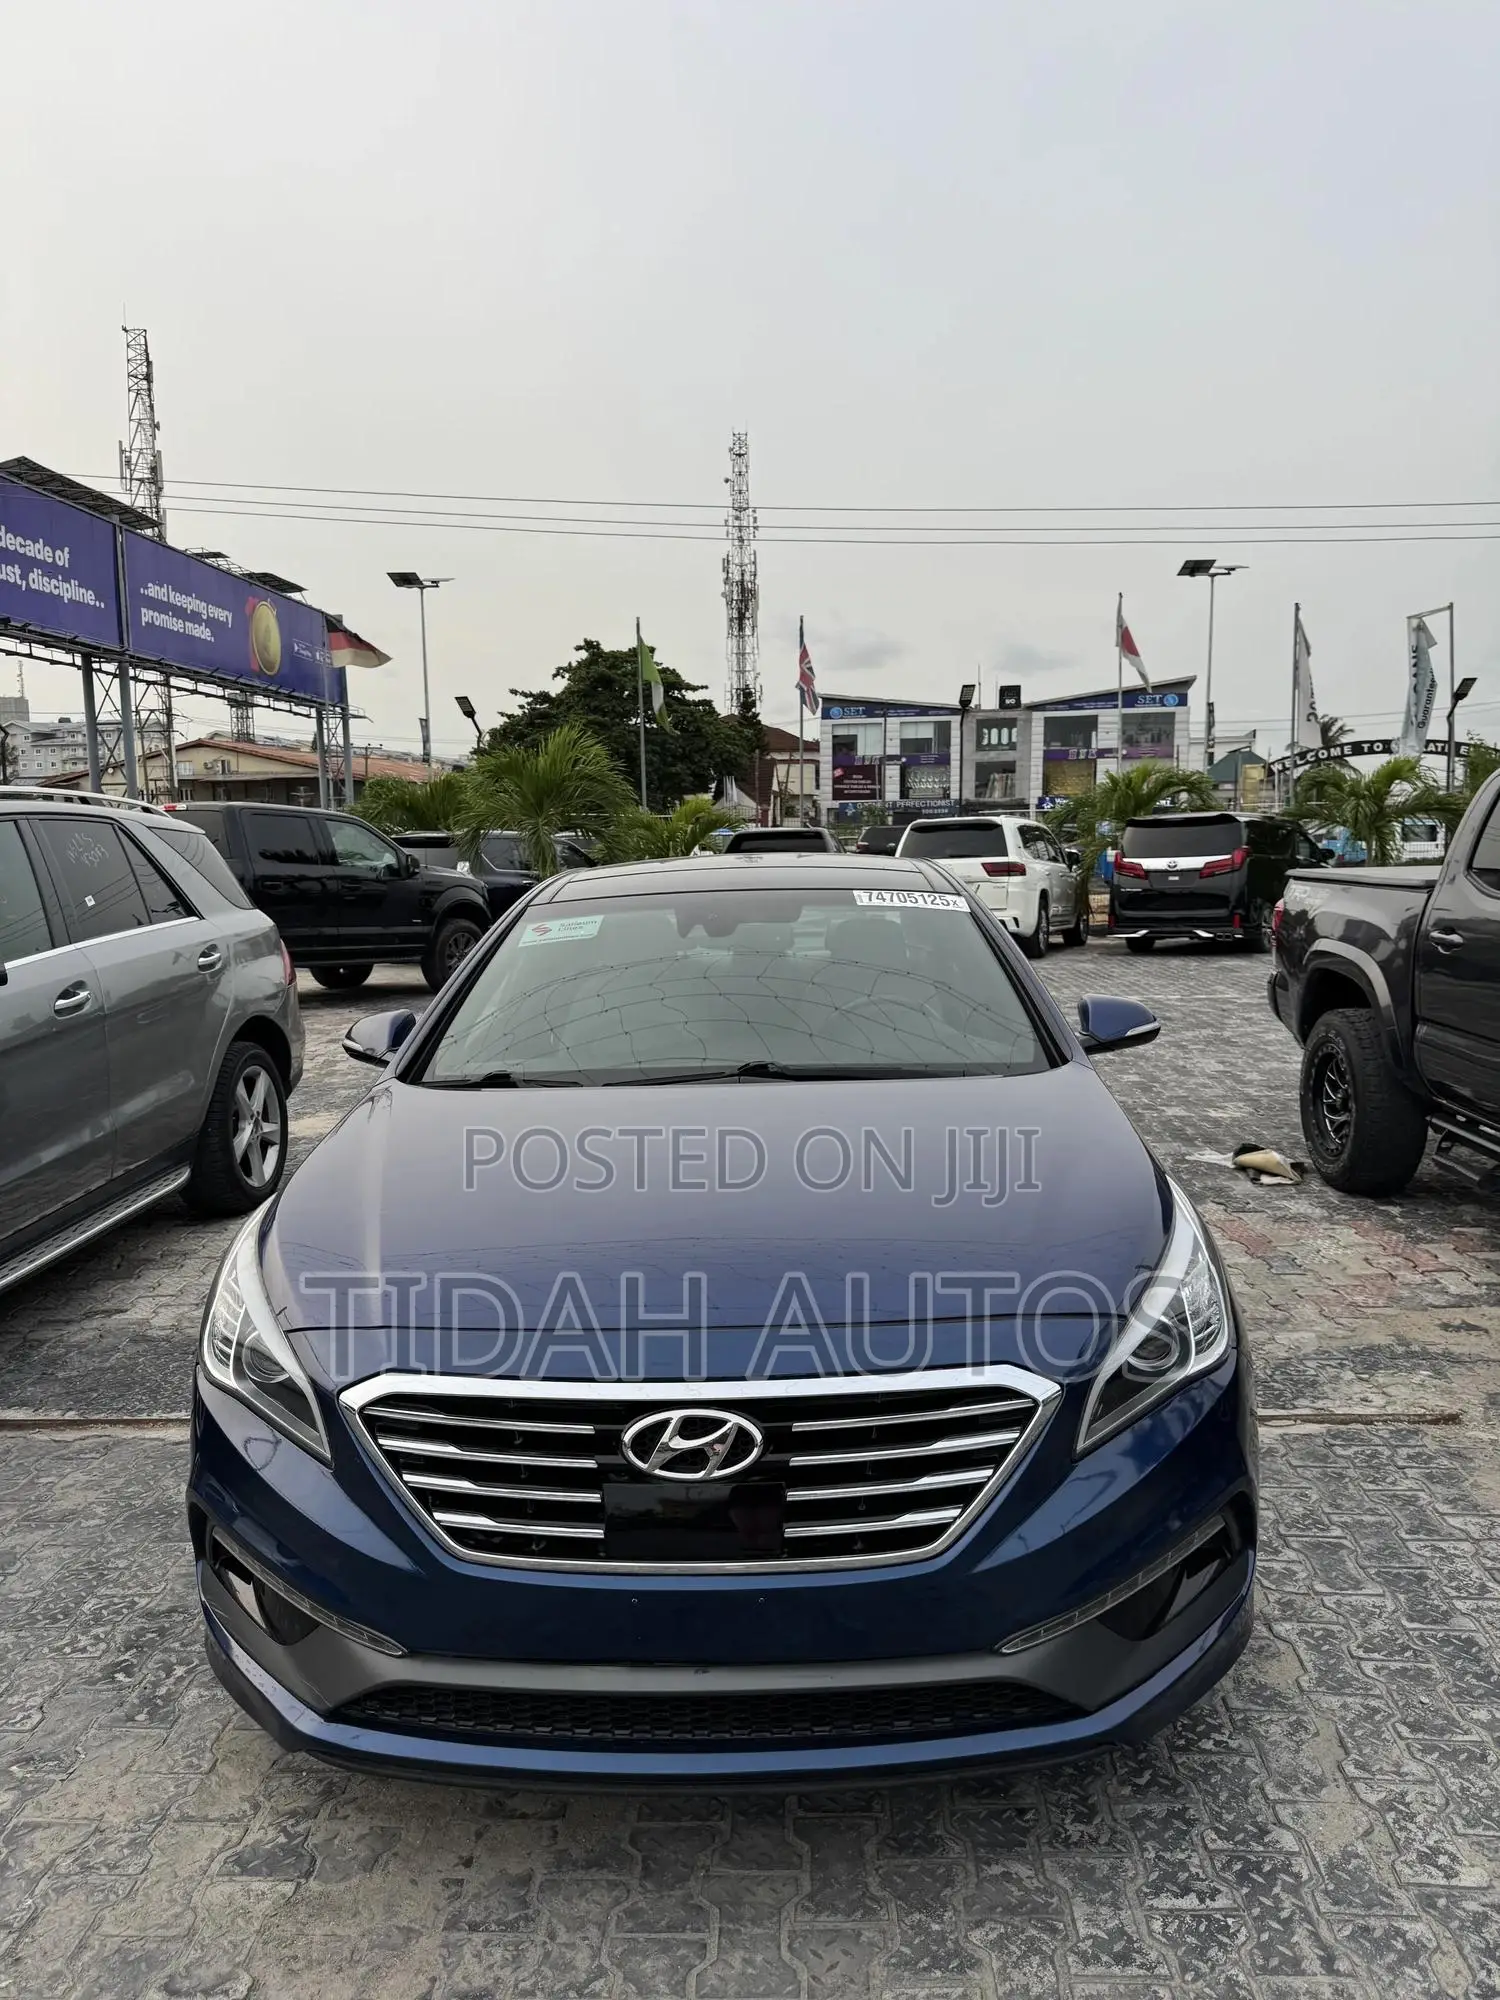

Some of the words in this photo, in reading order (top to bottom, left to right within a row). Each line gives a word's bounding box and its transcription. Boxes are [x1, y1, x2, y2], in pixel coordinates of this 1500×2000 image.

[0, 525, 53, 563] decade
[55, 547, 70, 568] of
[168, 585, 208, 620] keeping
[207, 604, 232, 628] every
[141, 607, 184, 633] promise
[184, 621, 215, 643] made.
[843, 707, 866, 716] SET
[1137, 694, 1162, 704] SET
[1270, 744, 1353, 773] WELCOME
[1361, 742, 1384, 753] TO
